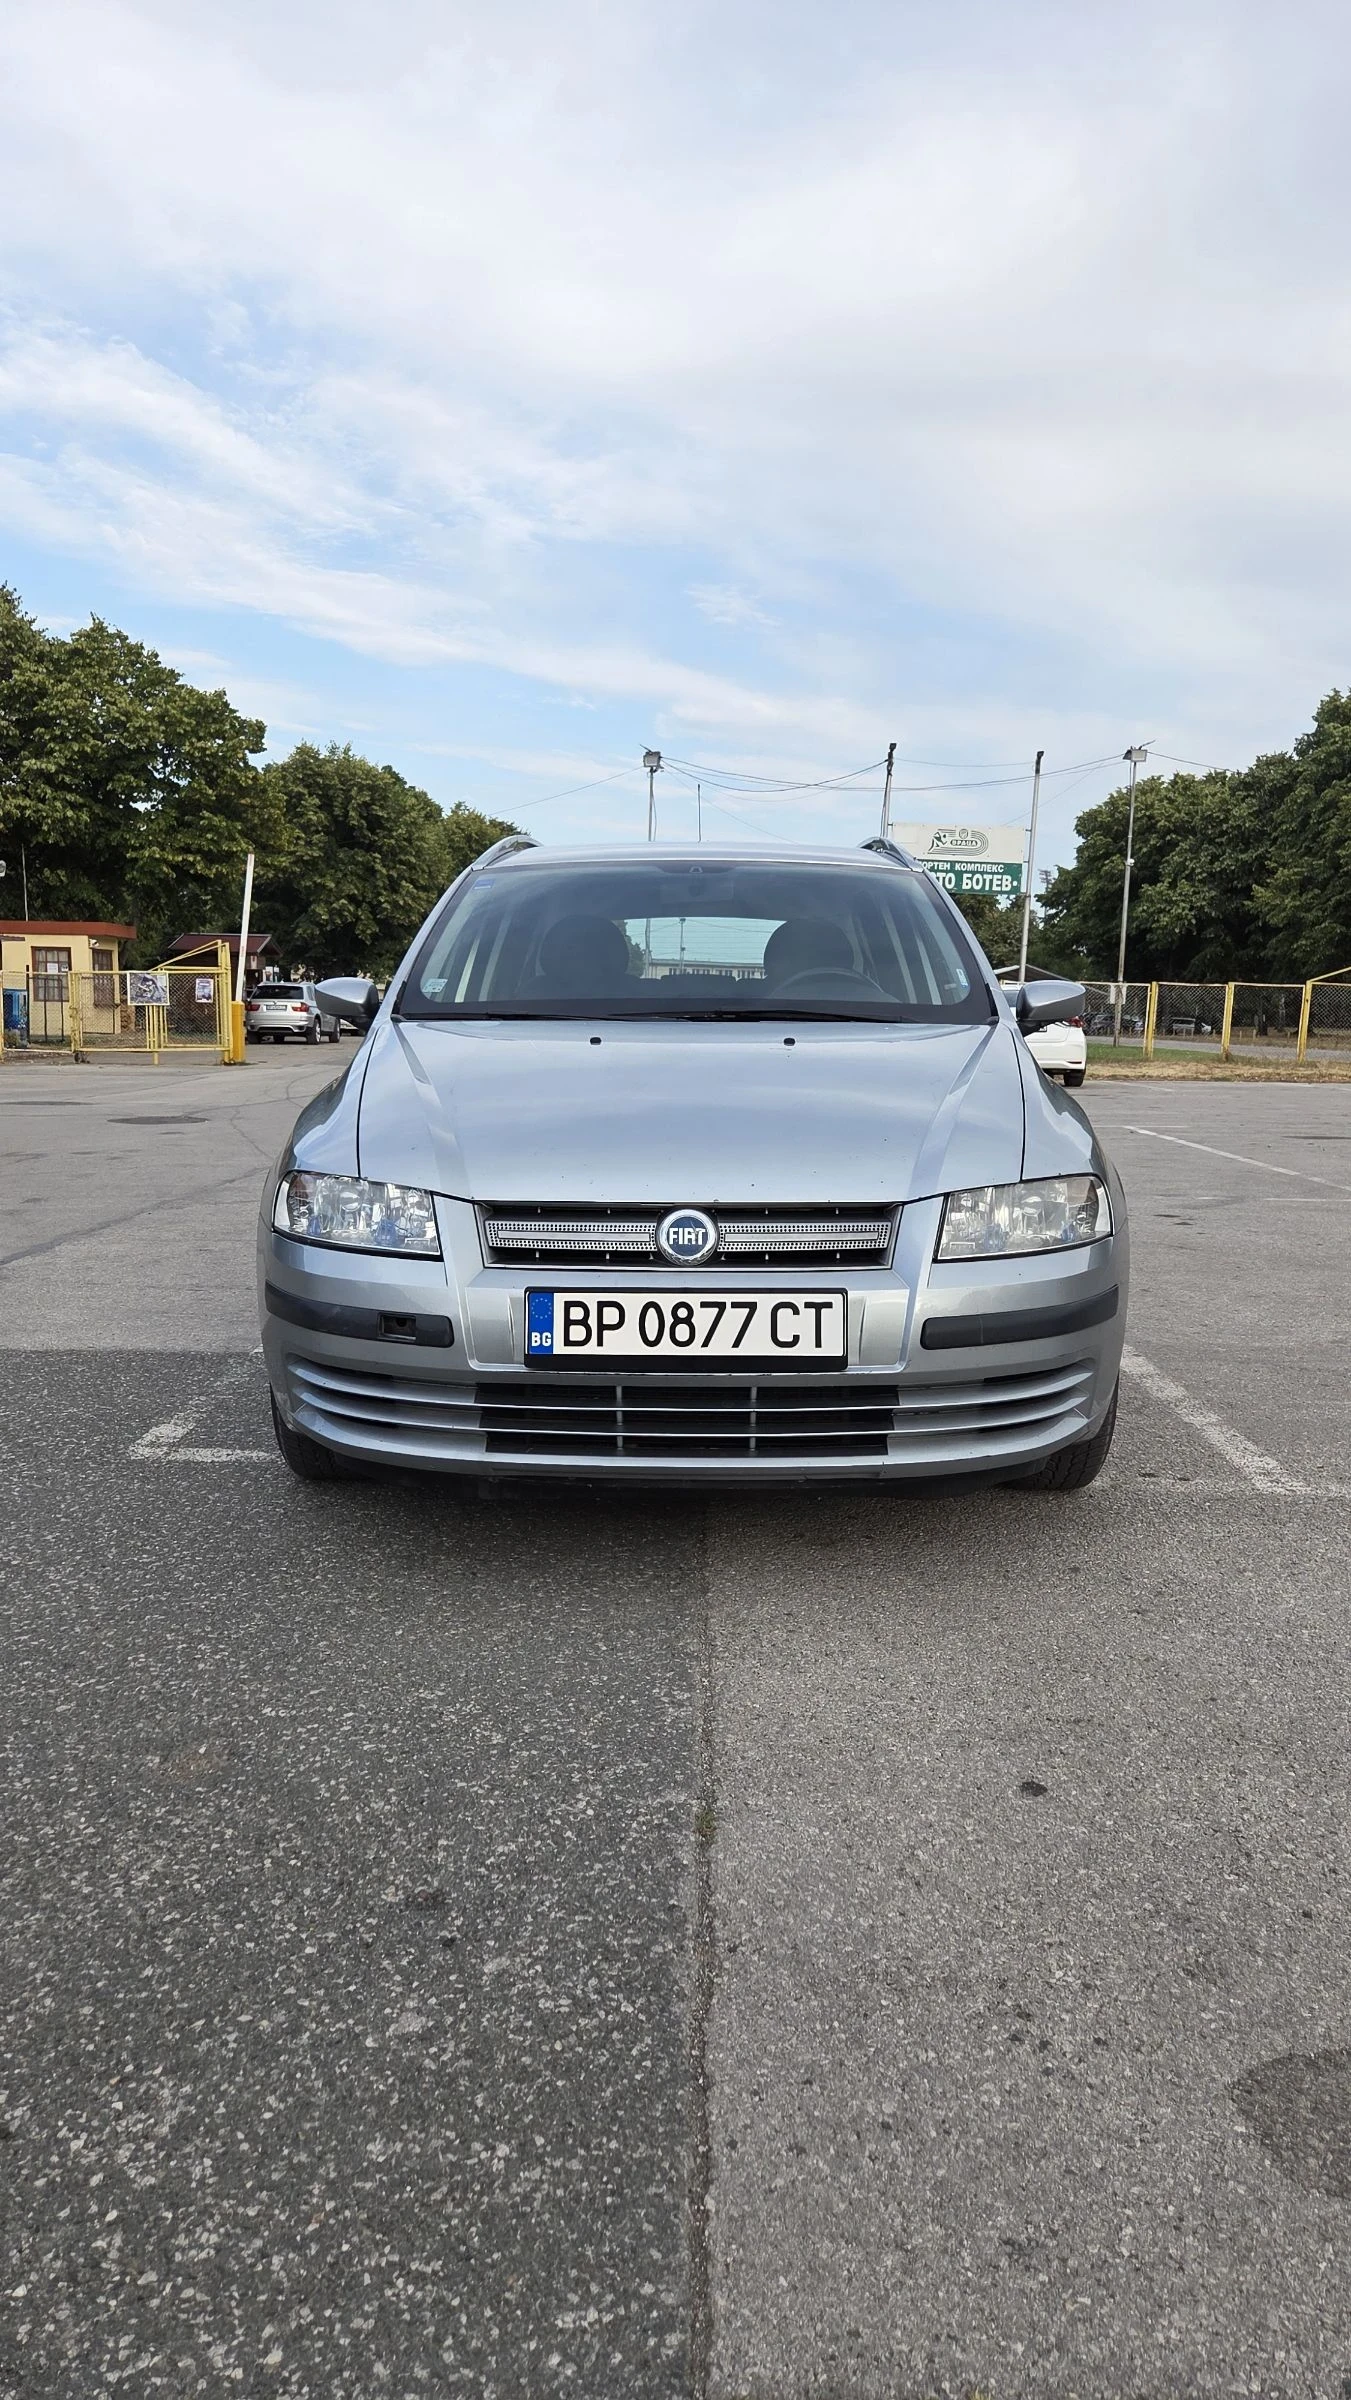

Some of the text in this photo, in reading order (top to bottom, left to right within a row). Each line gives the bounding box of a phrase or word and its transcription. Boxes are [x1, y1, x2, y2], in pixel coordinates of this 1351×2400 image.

[920, 861, 1004, 873] ОРТЕН КОМПЛЕКС
[669, 1227, 706, 1245] FIAT
[563, 1301, 833, 1348] BP 0877 CT
[531, 1332, 552, 1347] BG
